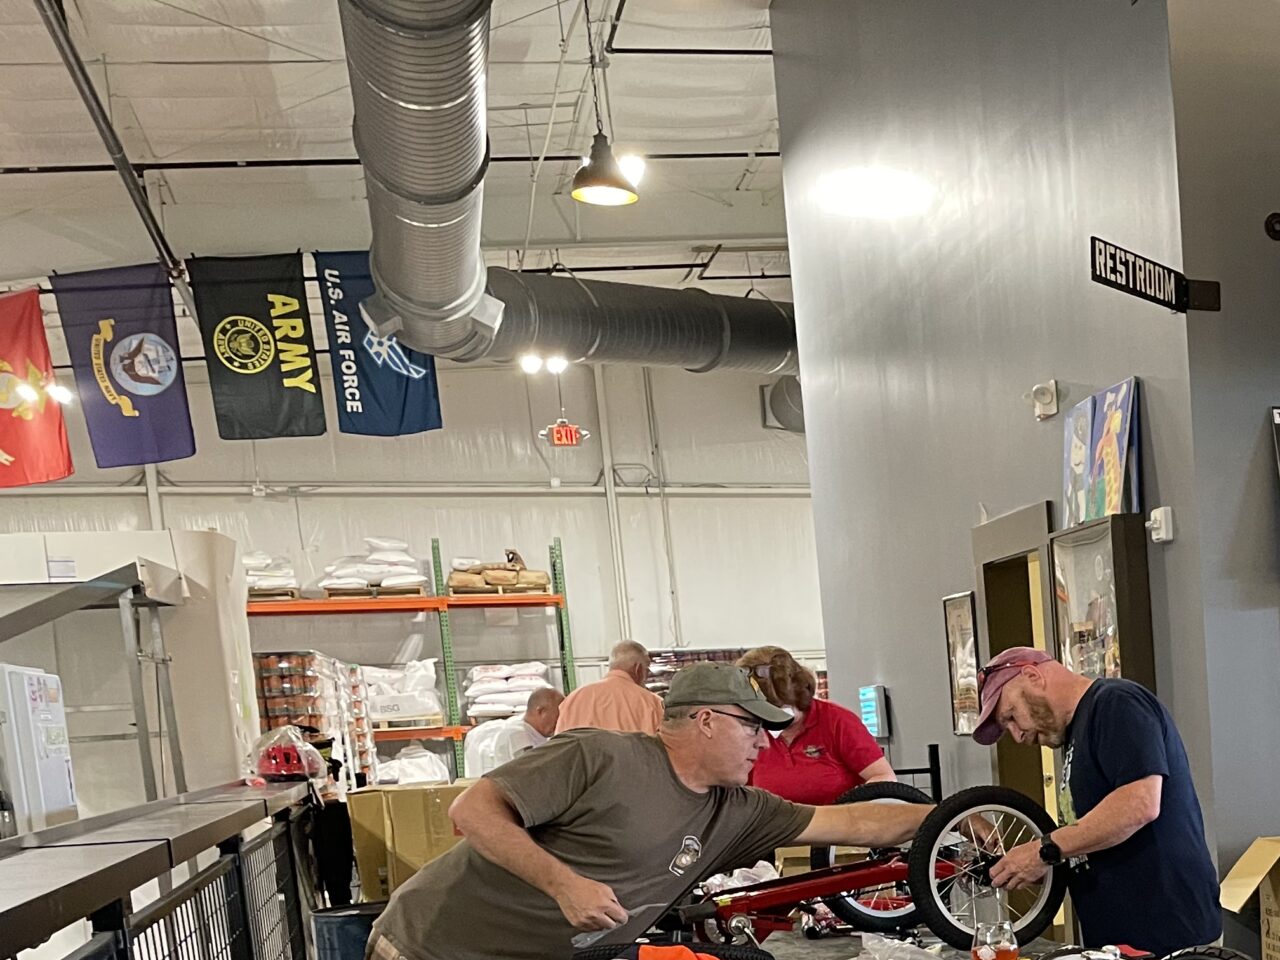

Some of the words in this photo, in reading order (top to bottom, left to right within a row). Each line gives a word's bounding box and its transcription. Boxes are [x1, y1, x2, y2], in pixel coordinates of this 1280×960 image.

[324, 268, 343, 305] U.S.
[1095, 240, 1175, 305] RESTROOM
[237, 320, 270, 342] UNITED
[267, 293, 317, 393] ARMY
[332, 310, 352, 345] AIR
[216, 333, 230, 358] ARMY
[247, 342, 271, 370] STATES
[339, 349, 363, 413] FORCE
[553, 427, 577, 445] EXIT
